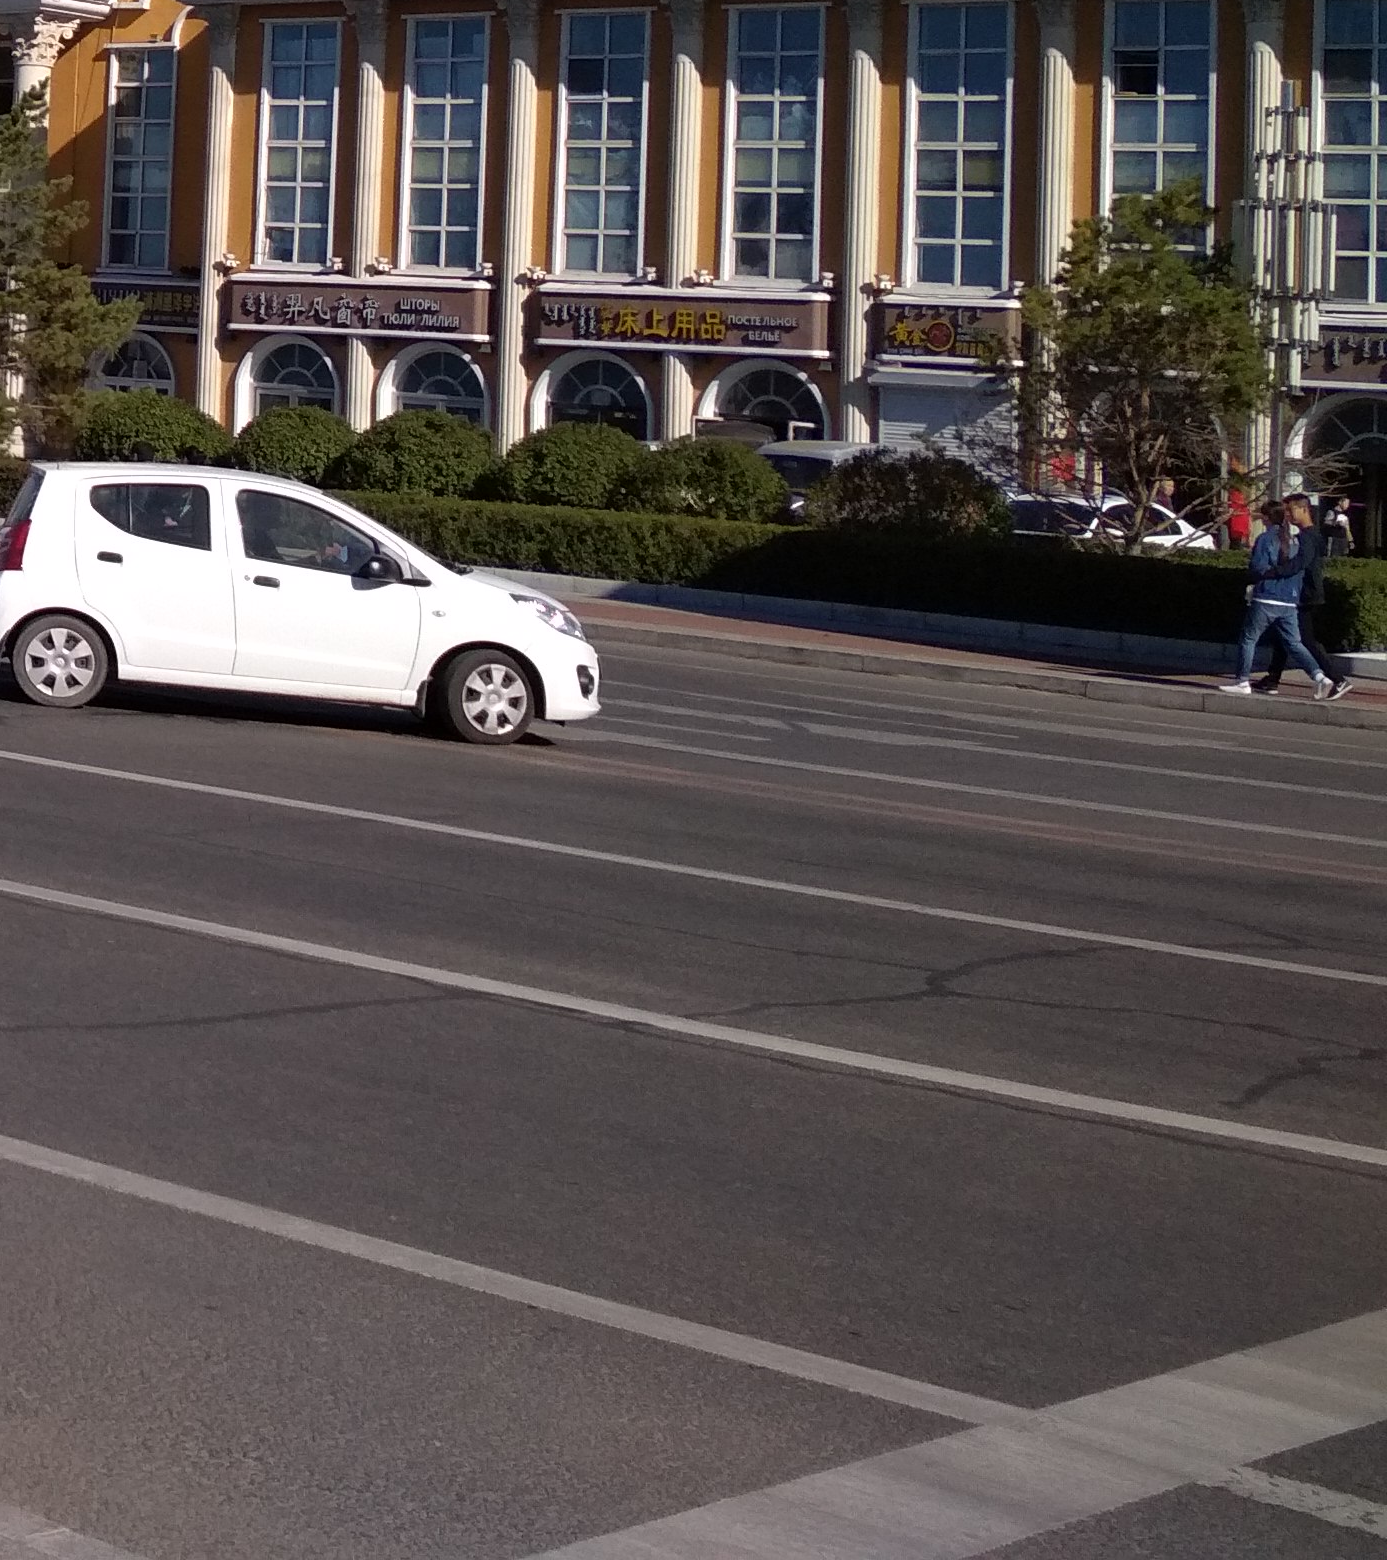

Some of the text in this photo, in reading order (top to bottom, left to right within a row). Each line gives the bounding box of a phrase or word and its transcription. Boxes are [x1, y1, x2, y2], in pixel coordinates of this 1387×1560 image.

[400, 297, 441, 312] ШТОРЫ
[420, 314, 460, 329] ЛИЛИЯ
[615, 306, 726, 340] 床上用品
[727, 314, 799, 328] ПОСТЕЛЬНОЕ
